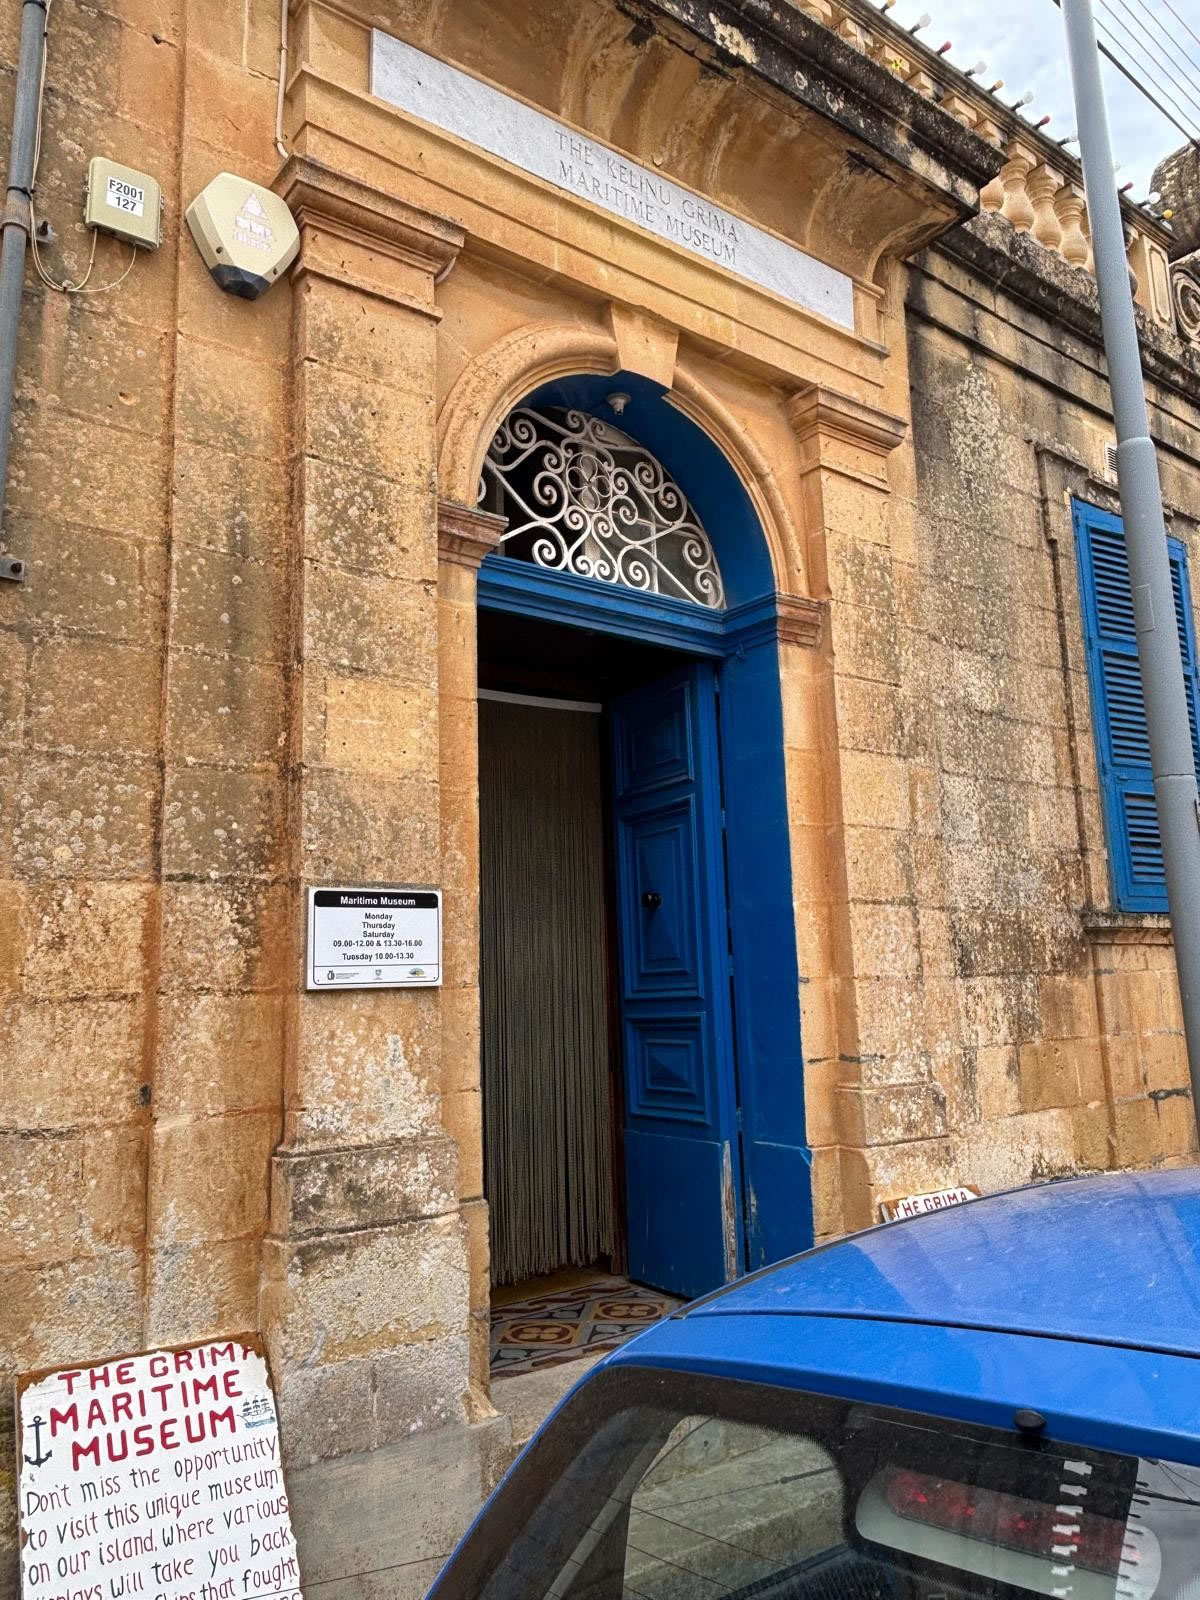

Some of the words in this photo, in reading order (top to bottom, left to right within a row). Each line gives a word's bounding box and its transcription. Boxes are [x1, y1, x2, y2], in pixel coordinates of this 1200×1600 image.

[109, 179, 143, 201] F2001
[115, 196, 137, 211] 127
[555, 130, 593, 167] THE
[606, 158, 671, 206] KELINU
[682, 200, 739, 242] GRIMA
[559, 160, 654, 223] MARITIME
[667, 215, 736, 264] MUSEUM
[340, 896, 378, 905] Maritime
[380, 896, 416, 906] Museum
[364, 912, 393, 920] Monday
[362, 921, 395, 930] Thursday
[362, 930, 395, 939] Saturday
[342, 953, 373, 962] Tuesday
[923, 1191, 968, 1211] GRIMA
[57, 1362, 136, 1395] THE
[50, 1369, 243, 1437] MARITIME
[71, 1405, 236, 1471] MUSEUM
[26, 1484, 71, 1516] Don't
[80, 1476, 121, 1503] miss
[129, 1468, 160, 1488] the
[174, 1435, 276, 1482] opportunity
[28, 1528, 48, 1550] to
[57, 1512, 98, 1544] visit
[104, 1502, 140, 1530] this
[146, 1489, 200, 1519] unique
[208, 1469, 278, 1501] museum
[28, 1562, 51, 1586] on
[57, 1550, 90, 1577] our
[223, 1495, 288, 1530] various
[151, 1558, 194, 1584] take
[208, 1544, 240, 1578] you
[250, 1526, 290, 1557] back
[200, 1577, 236, 1600] that
[242, 1556, 297, 1590] fought
